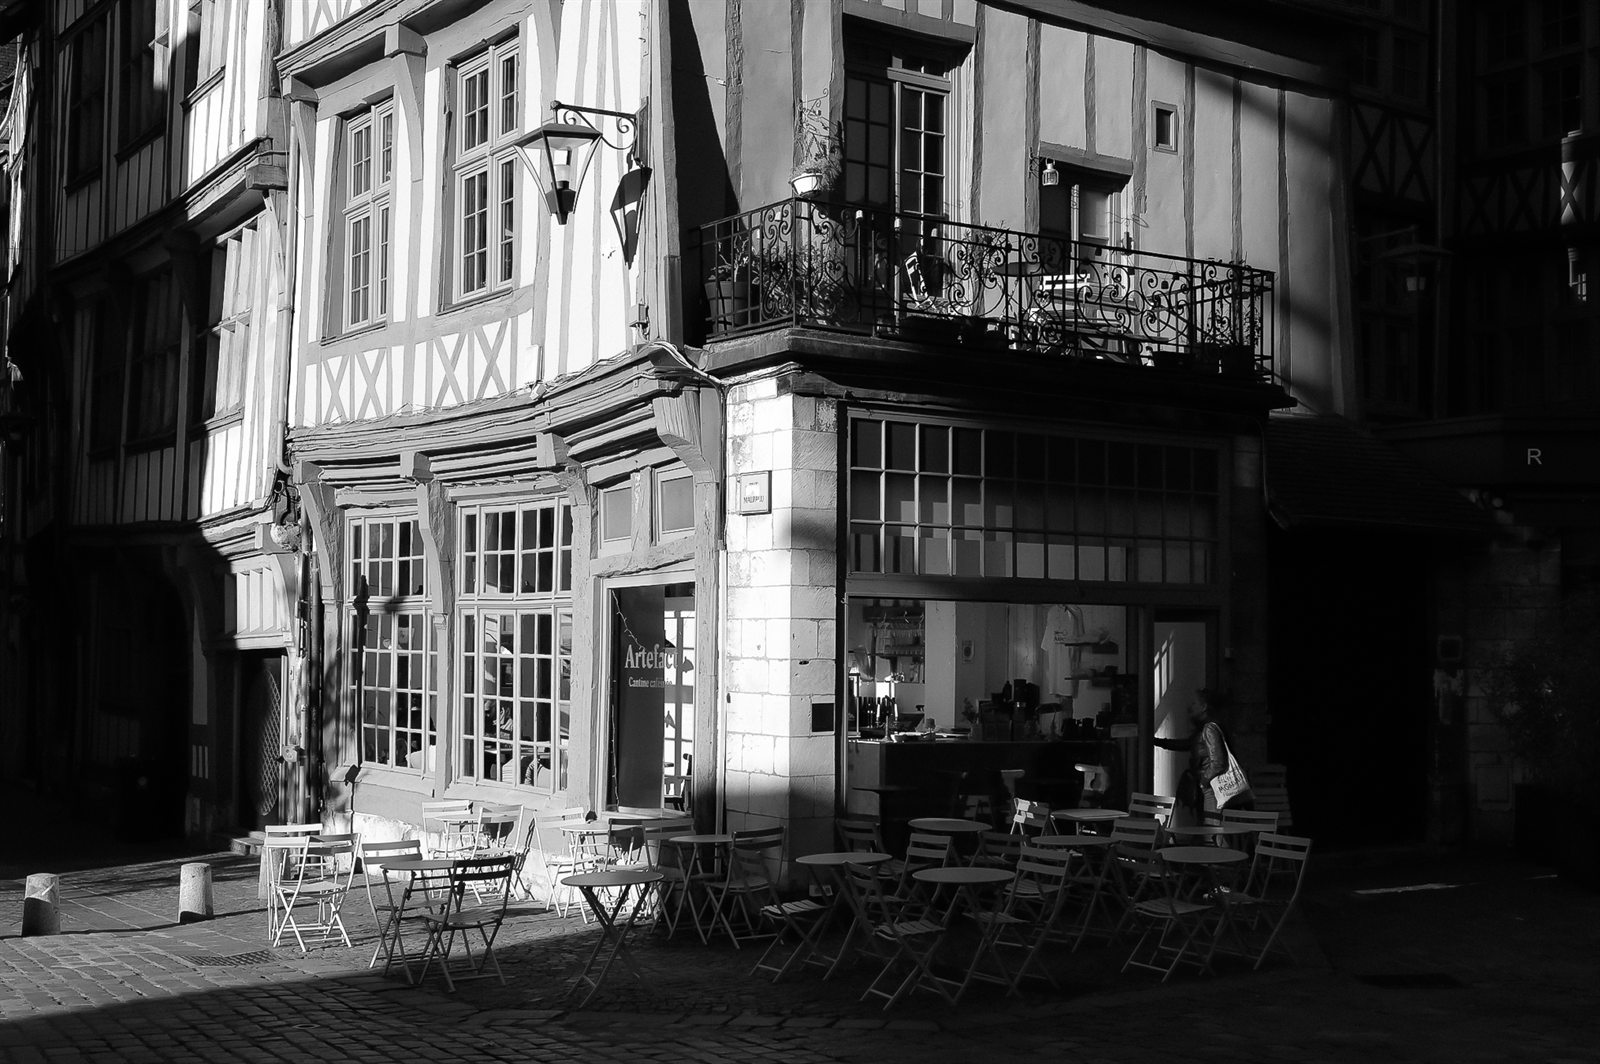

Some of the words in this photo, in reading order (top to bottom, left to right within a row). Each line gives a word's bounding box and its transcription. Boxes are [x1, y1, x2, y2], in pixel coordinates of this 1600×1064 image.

[1526, 448, 1543, 465] R
[624, 643, 678, 669] Artefact
[628, 676, 649, 688] Cantine
